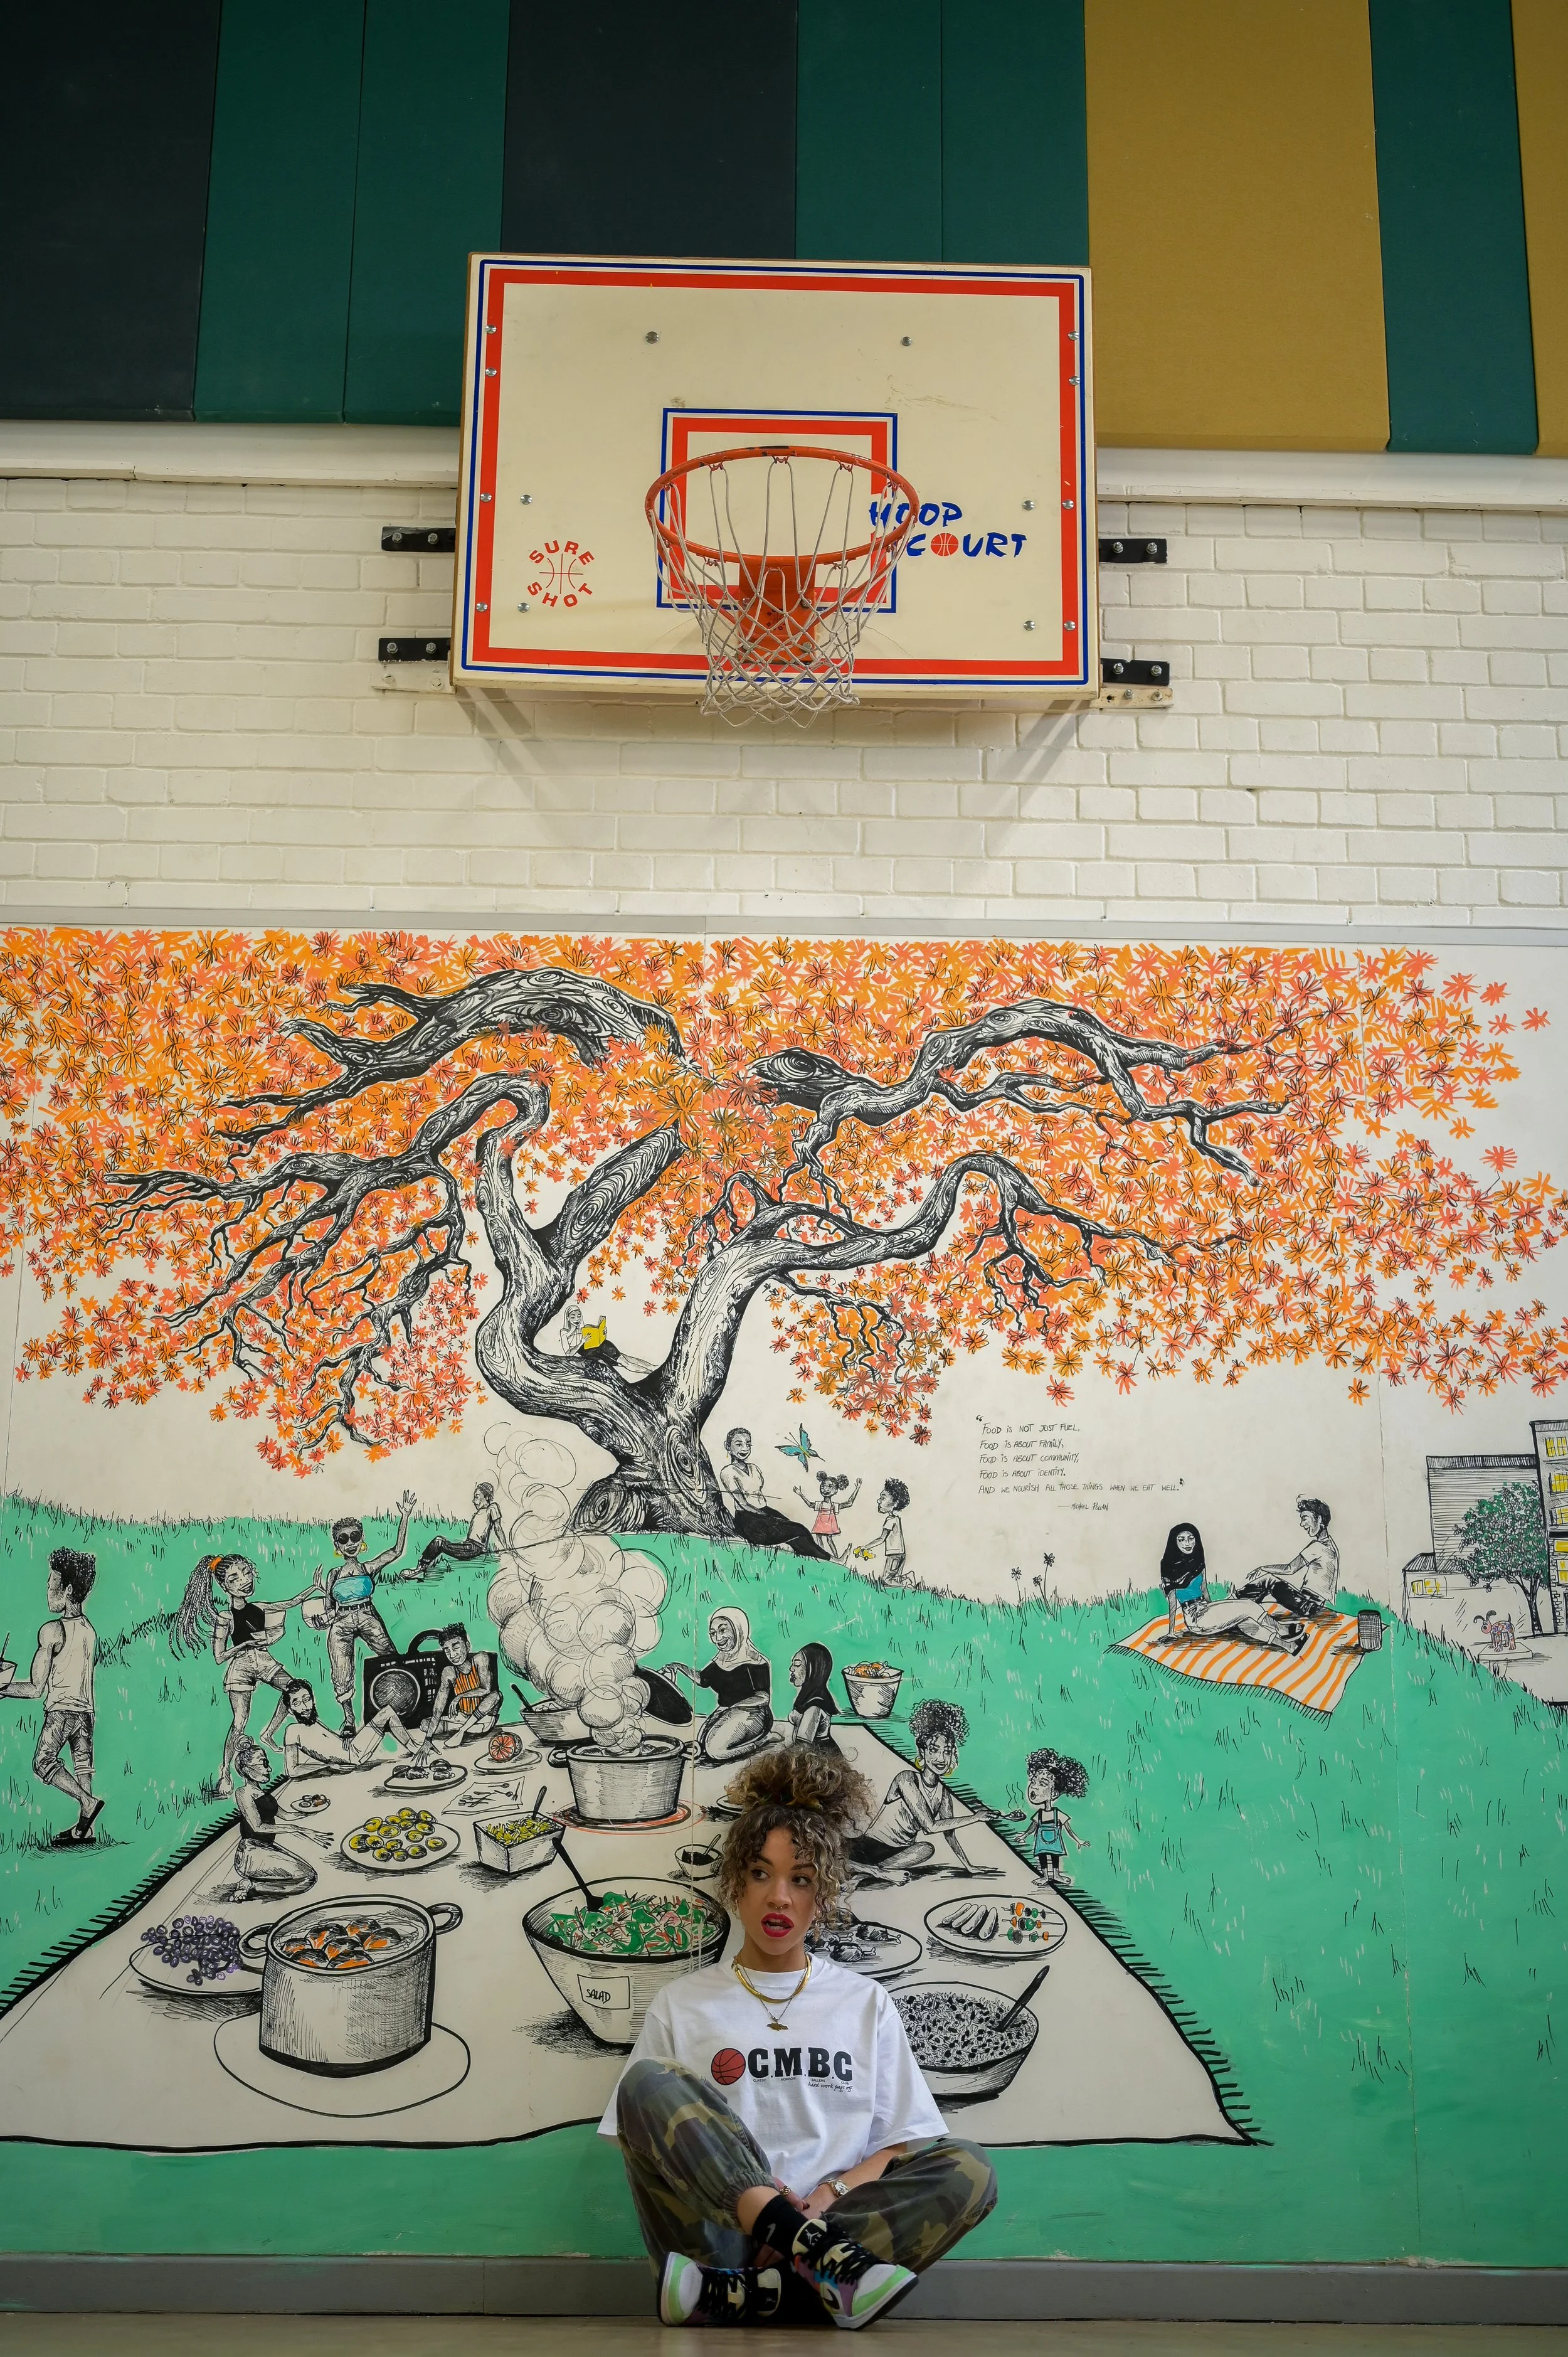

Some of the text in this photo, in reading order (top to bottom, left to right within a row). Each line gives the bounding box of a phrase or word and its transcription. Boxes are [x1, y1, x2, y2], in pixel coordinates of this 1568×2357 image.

[869, 501, 963, 528] HOOP
[906, 531, 1027, 558] COURT
[529, 540, 595, 566] SURE
[527, 582, 593, 608] SHOT
[1019, 1423, 1035, 1432] NOT
[1039, 1423, 1057, 1432] JUST
[1060, 1423, 1080, 1432] FUEL,
[980, 1440, 999, 1450] FOOD
[980, 1454, 997, 1464] FOOD
[1013, 1454, 1037, 1463] ABOUT
[980, 1469, 998, 1479] FOOD
[1012, 1469, 1034, 1477] ABOUT
[978, 1485, 995, 1494] AND
[1013, 1483, 1039, 1492] NOURISH
[1093, 1503, 1109, 1511] POLLAN
[585, 1989, 611, 2004] SALAD
